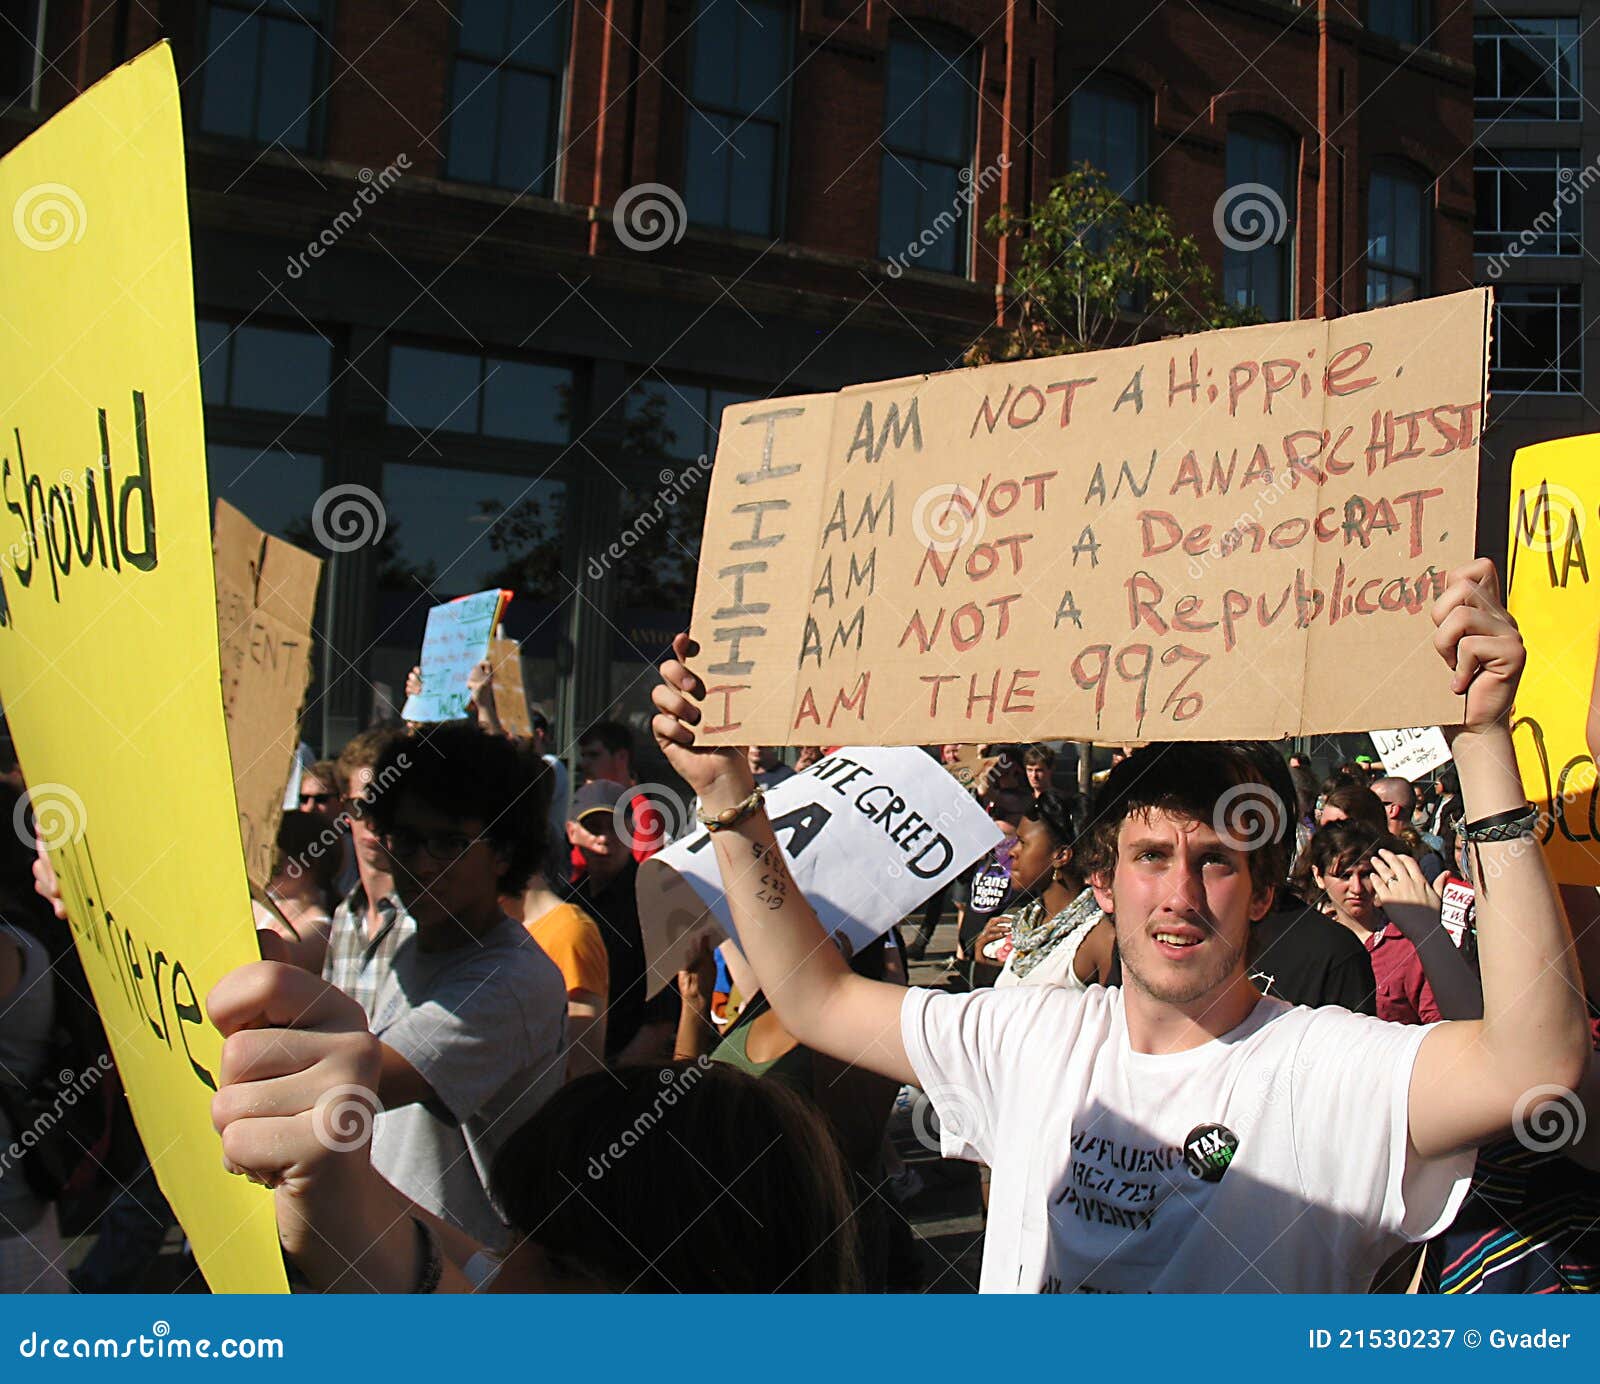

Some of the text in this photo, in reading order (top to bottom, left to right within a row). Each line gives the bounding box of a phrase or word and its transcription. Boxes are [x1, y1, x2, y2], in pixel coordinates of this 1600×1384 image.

[736, 407, 805, 485] I
[846, 397, 923, 463] AM
[970, 377, 1097, 439] NOT
[1113, 364, 1144, 414] A
[3, 389, 158, 603] should
[730, 499, 791, 550] I
[821, 480, 895, 549] AM
[938, 470, 1058, 527] NOT
[1084, 448, 1158, 507] AN
[707, 557, 1448, 676] I AM NOT A Republican
[711, 560, 771, 620] I
[812, 547, 877, 608] AM
[913, 533, 1034, 588] NOT
[1071, 524, 1102, 568] A
[702, 643, 1211, 738] I AM THE 99%
[854, 785, 954, 880] GREED
[1188, 1129, 1226, 1160] TAX
